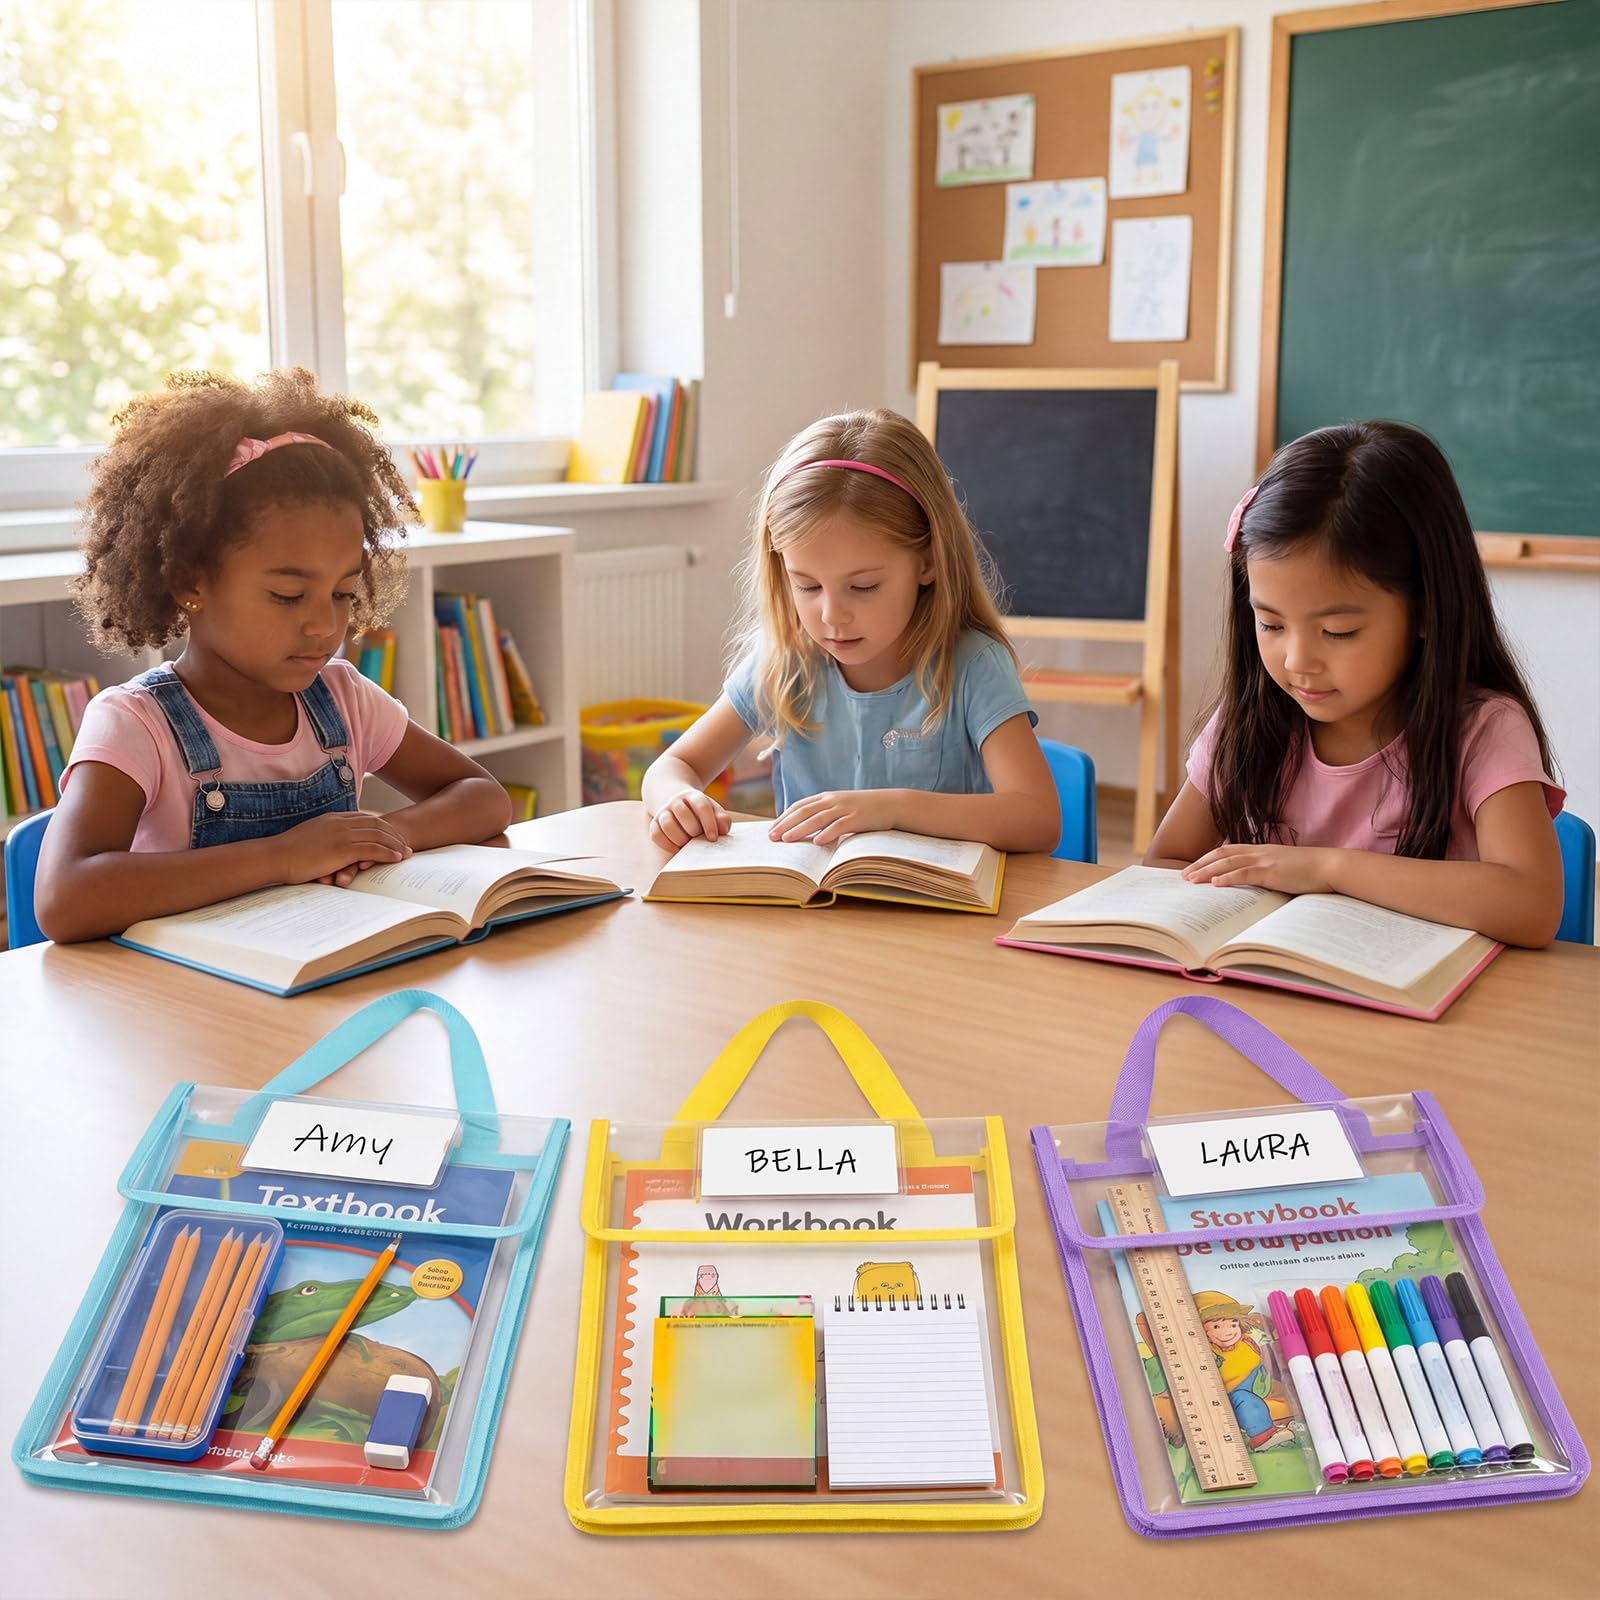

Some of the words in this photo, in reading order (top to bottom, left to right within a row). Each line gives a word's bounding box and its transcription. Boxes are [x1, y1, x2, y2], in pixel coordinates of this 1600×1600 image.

[293, 1124, 393, 1165] Amy
[1200, 1133, 1310, 1166] LAURA
[744, 1148, 857, 1175] BELLA
[257, 1185, 448, 1224] Textbook
[1190, 1197, 1361, 1229] Storybook
[705, 1211, 898, 1231] Workbook
